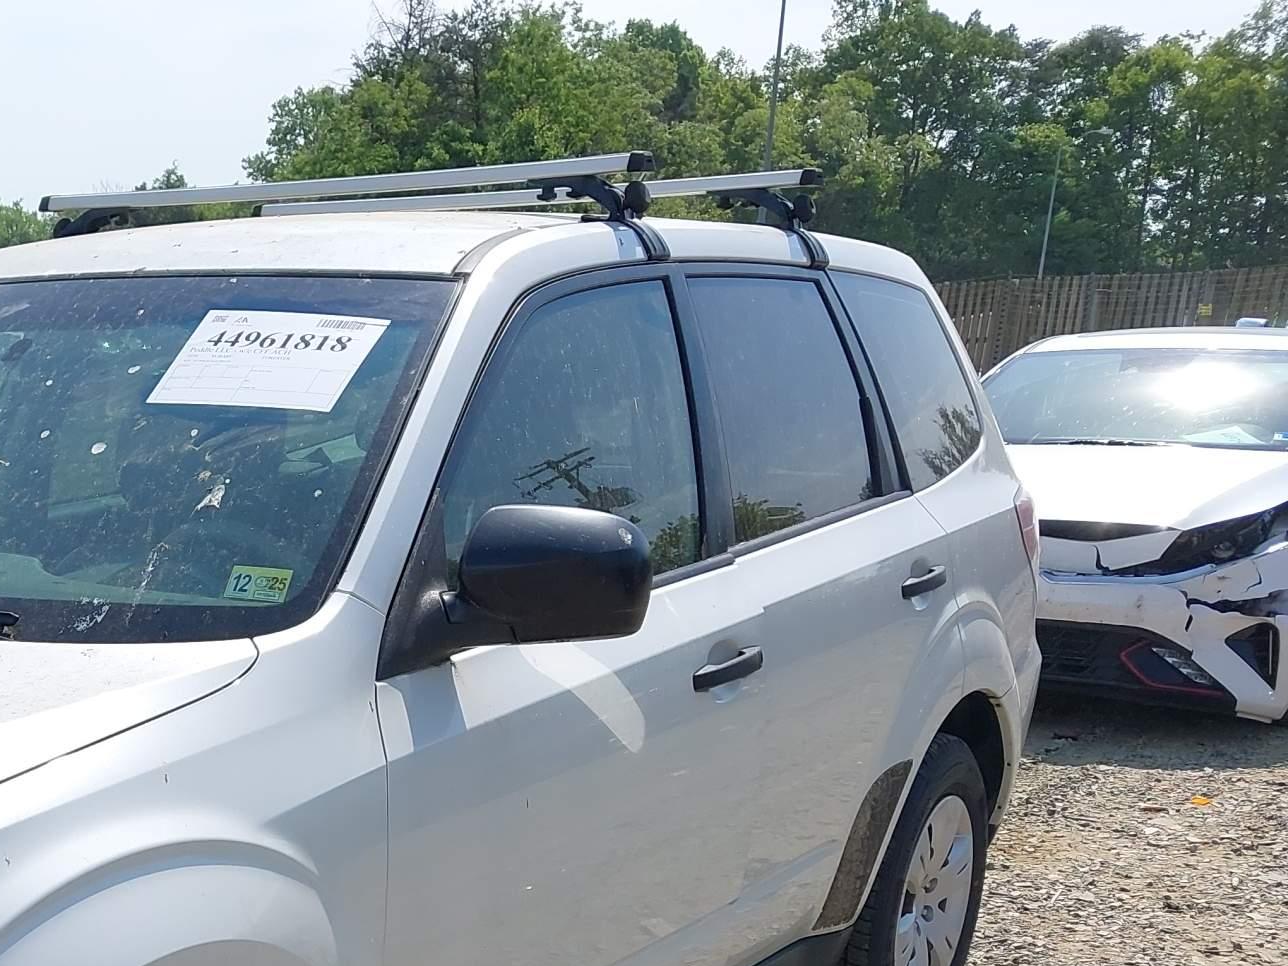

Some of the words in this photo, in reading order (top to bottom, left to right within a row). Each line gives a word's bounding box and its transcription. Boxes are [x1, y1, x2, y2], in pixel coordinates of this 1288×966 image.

[207, 330, 353, 352] 44961818
[232, 573, 252, 592] 12
[268, 576, 289, 592] 25
